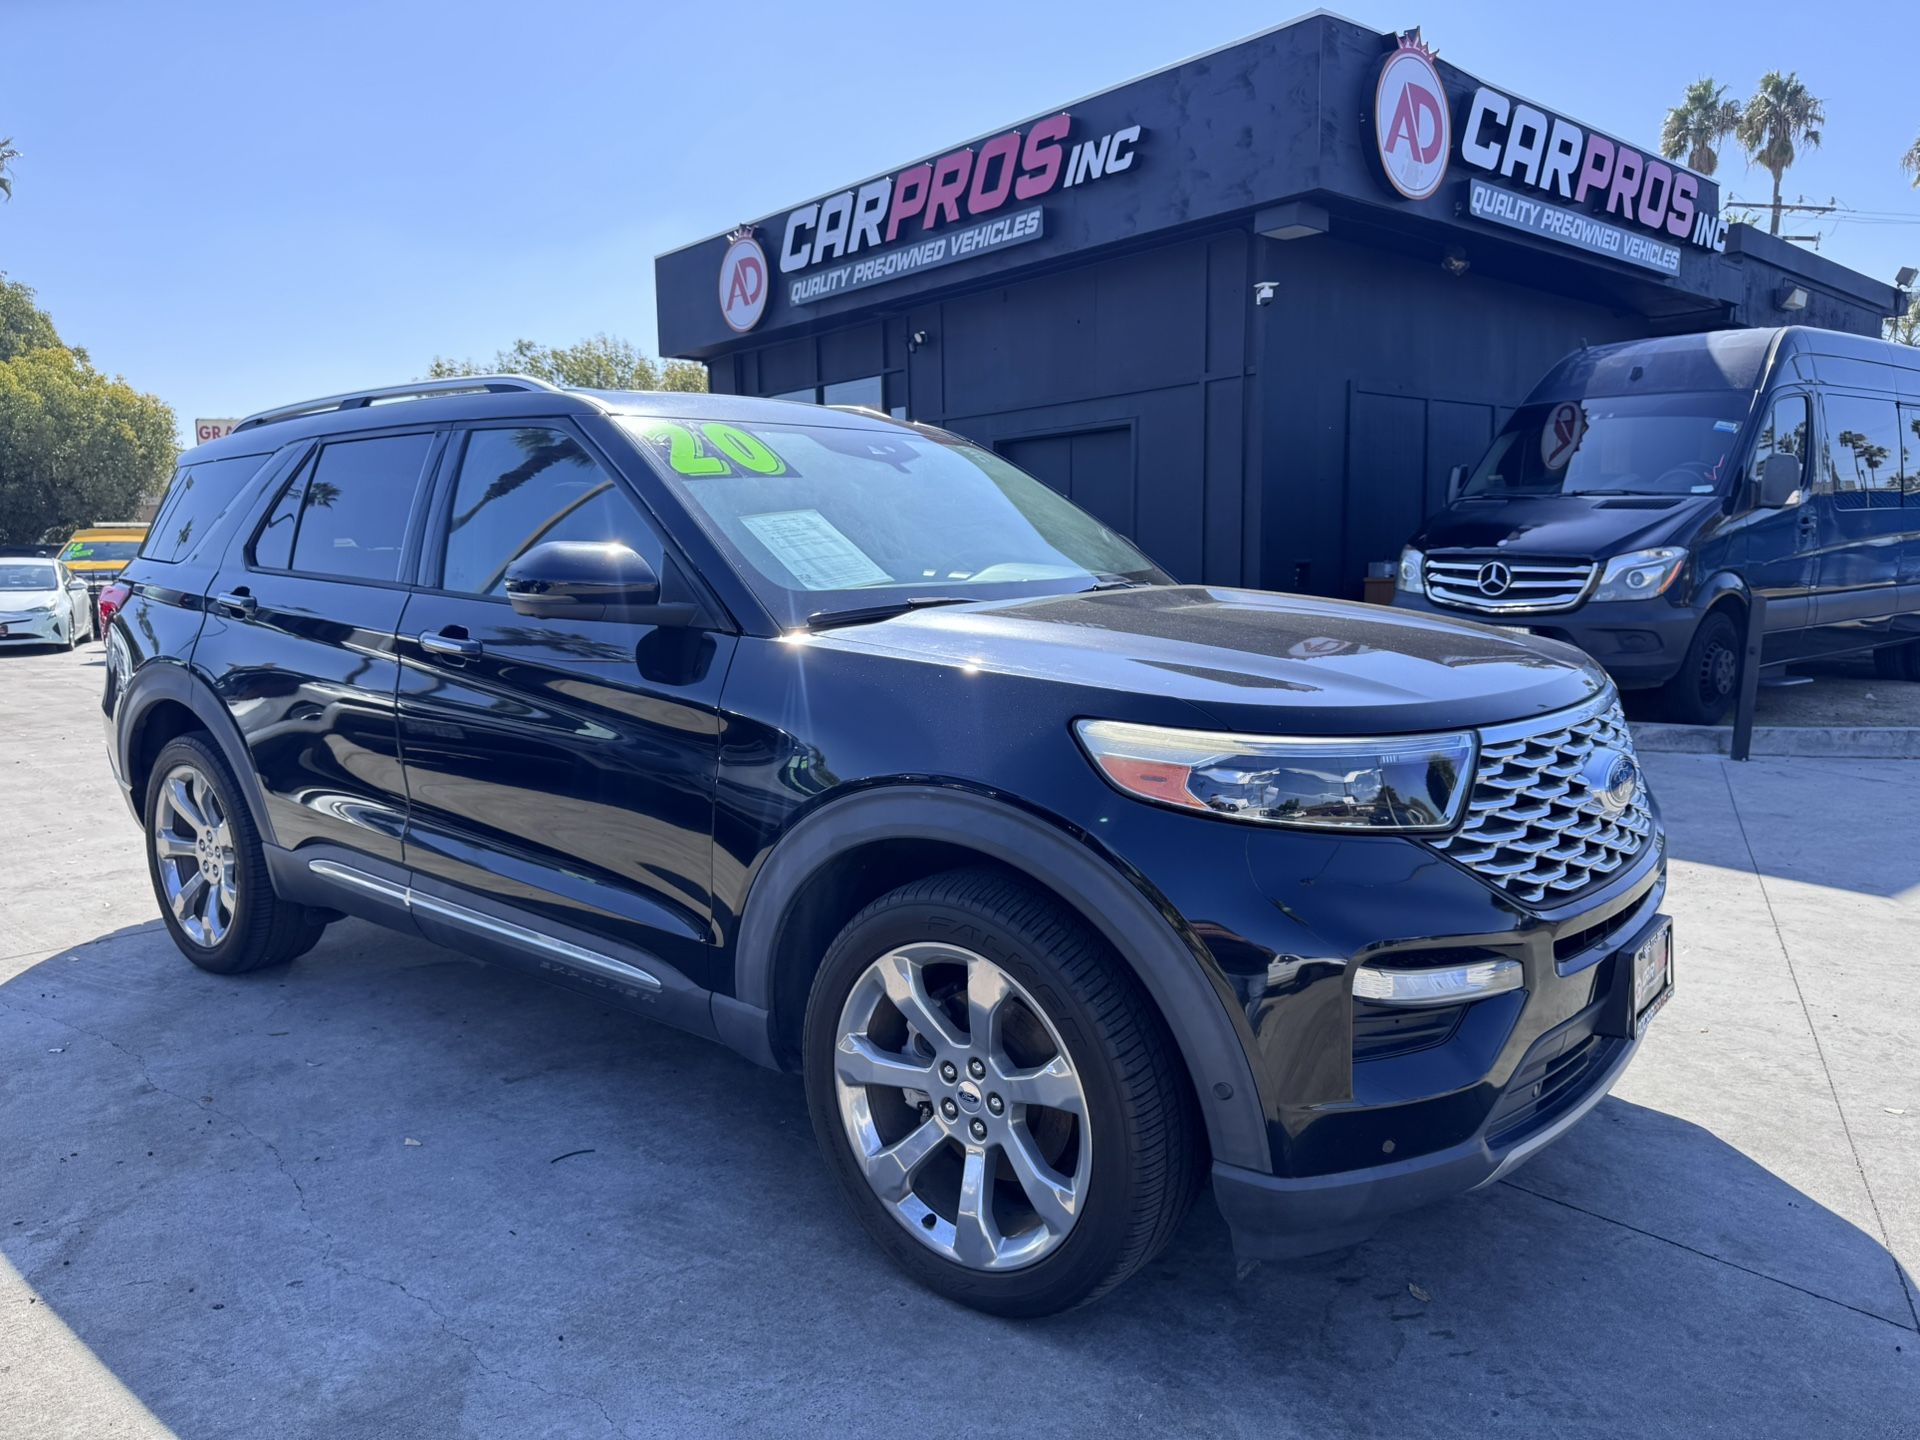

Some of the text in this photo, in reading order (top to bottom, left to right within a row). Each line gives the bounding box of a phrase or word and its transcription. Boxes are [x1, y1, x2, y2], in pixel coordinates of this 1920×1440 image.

[1384, 82, 1443, 164] AD
[1064, 125, 1142, 188] INC
[791, 267, 852, 304] QUALITY
[951, 210, 1041, 256] VEHICLES
[1471, 185, 1541, 226] QUALITY
[1623, 234, 1680, 271] VEHICLES
[1692, 212, 1729, 253] INC
[726, 257, 763, 313] AD
[641, 422, 787, 477] 20
